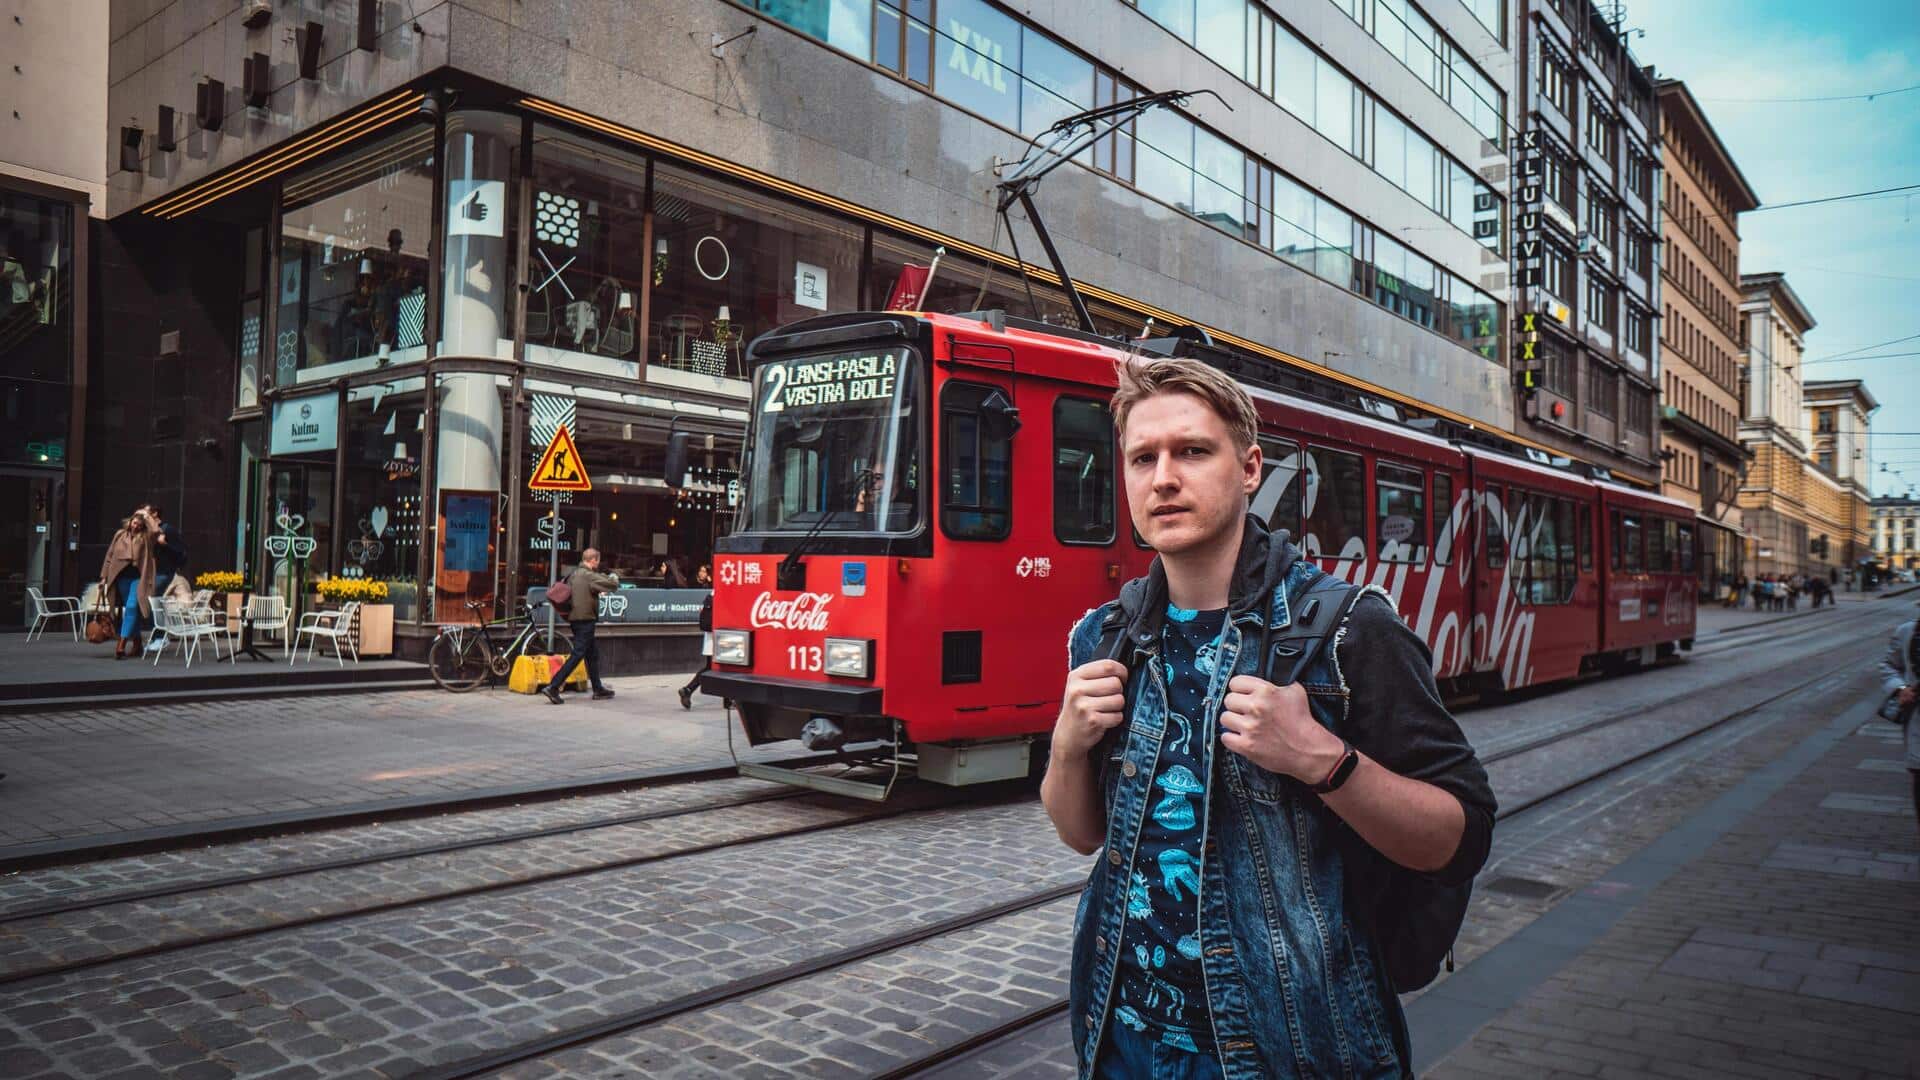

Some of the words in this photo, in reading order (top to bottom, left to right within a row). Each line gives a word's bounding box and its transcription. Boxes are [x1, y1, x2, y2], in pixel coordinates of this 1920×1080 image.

[949, 18, 1007, 95] XXL
[1523, 132, 1536, 285] KLUUVI
[1523, 314, 1536, 388] XXL
[763, 364, 787, 413] 2
[751, 591, 834, 631] Coca-Cola
[787, 645, 822, 672] 113
